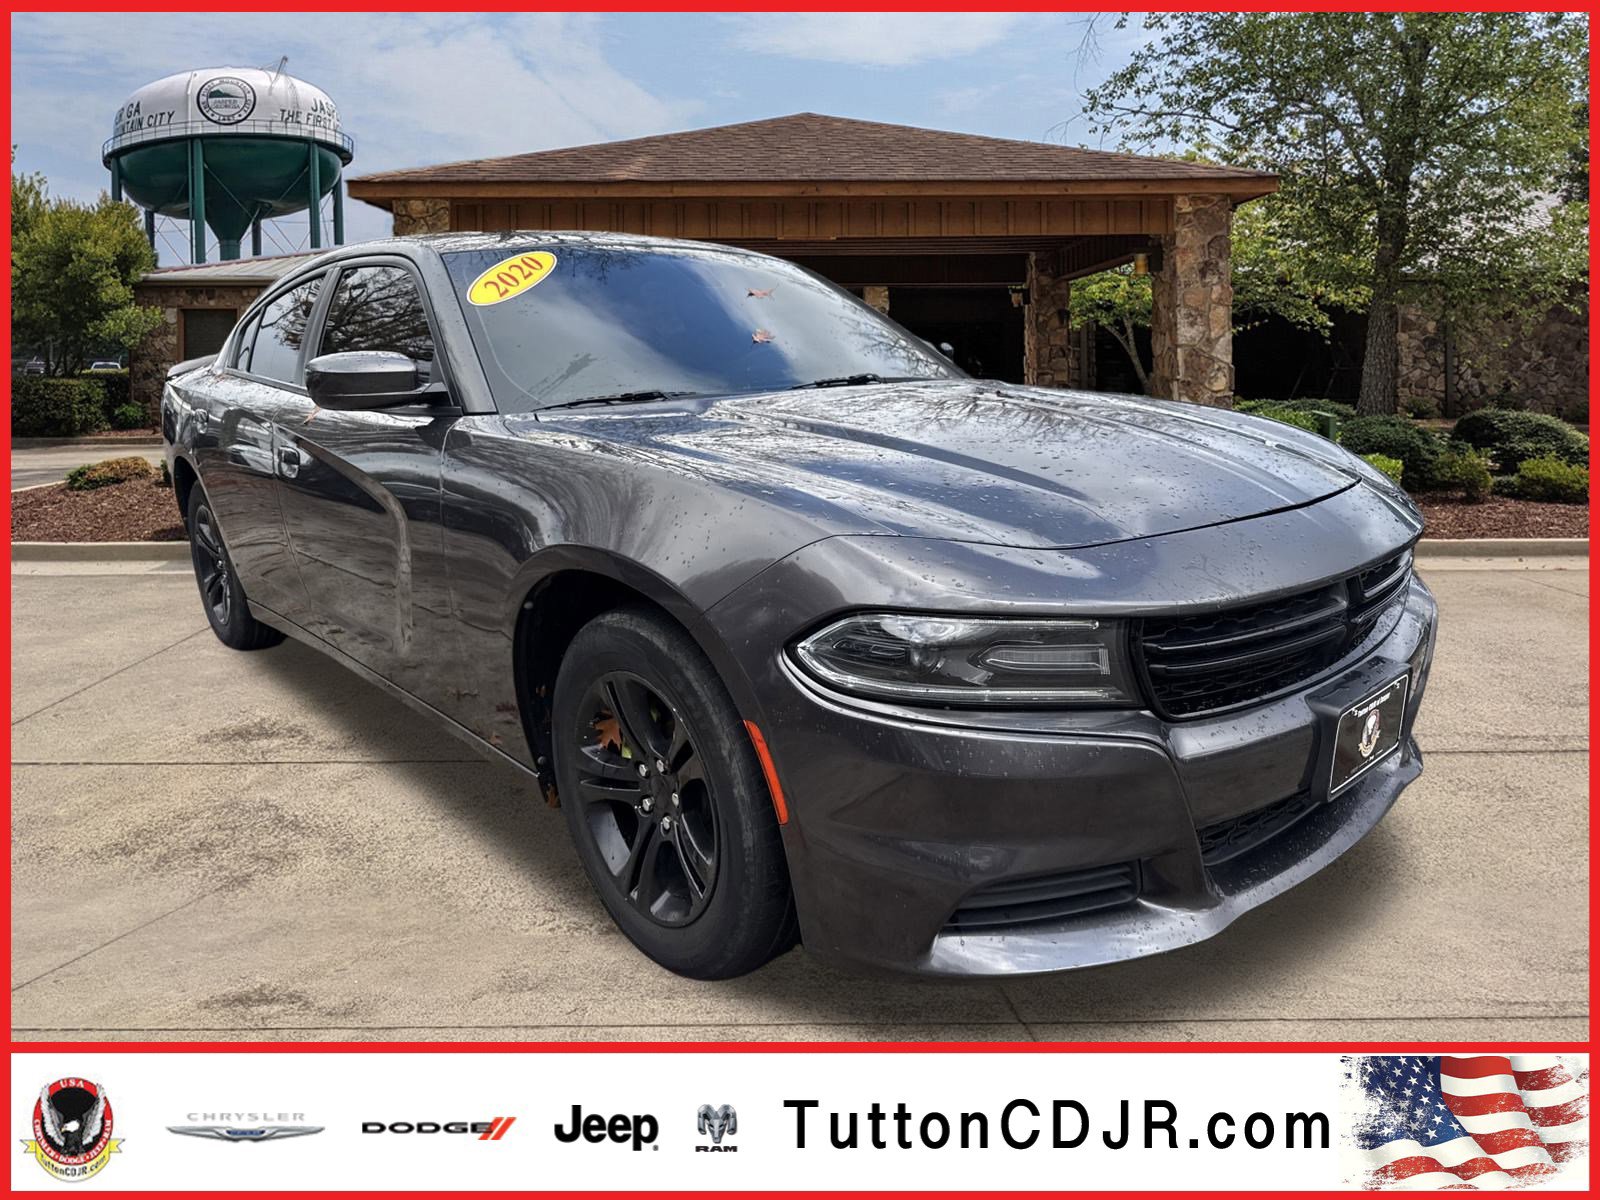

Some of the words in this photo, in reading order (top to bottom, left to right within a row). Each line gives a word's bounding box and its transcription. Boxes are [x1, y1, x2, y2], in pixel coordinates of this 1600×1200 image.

[126, 101, 140, 119] GA
[147, 110, 175, 127] CITY
[280, 109, 302, 124] THE
[484, 256, 543, 298] 2020
